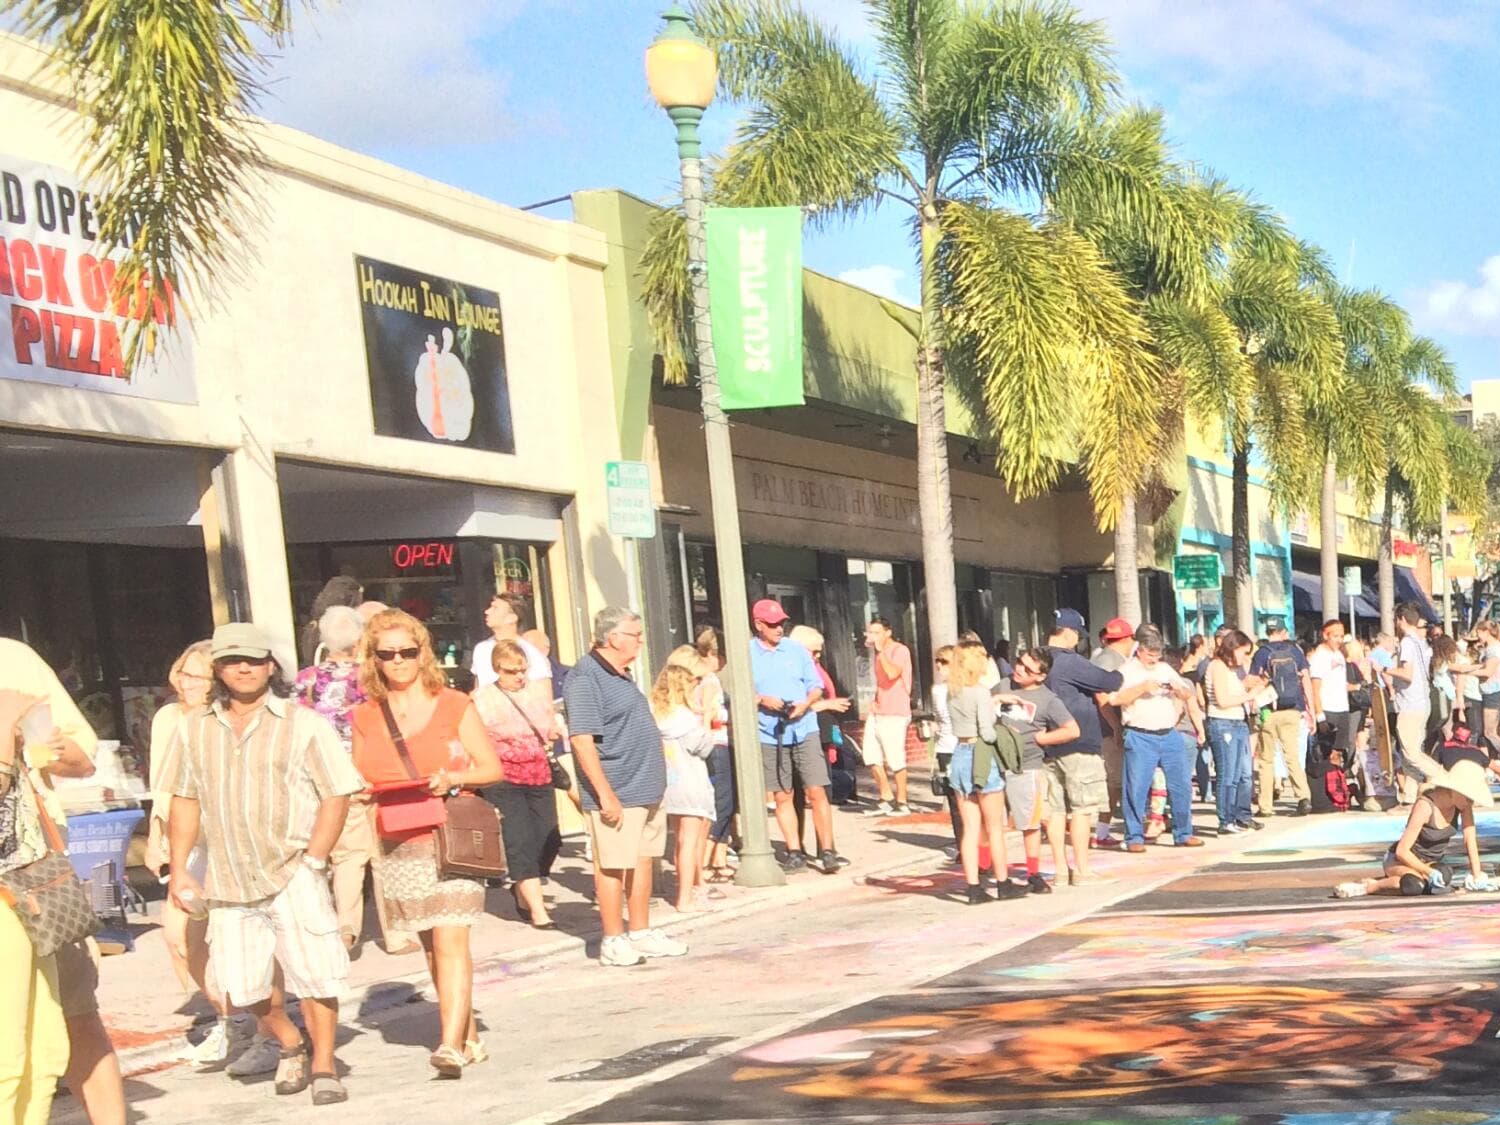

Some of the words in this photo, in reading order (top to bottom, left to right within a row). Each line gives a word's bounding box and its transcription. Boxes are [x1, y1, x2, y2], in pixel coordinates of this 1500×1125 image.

[359, 263, 418, 314] HOOKAH
[420, 280, 450, 322] INN
[452, 288, 501, 335] LOUNGE
[738, 225, 771, 373] SCULPTURE
[11, 303, 128, 379] PIZZA
[753, 472, 796, 503] PALM
[798, 480, 849, 515] BEACH
[852, 489, 891, 520] HOME
[394, 543, 454, 568] OPEN
